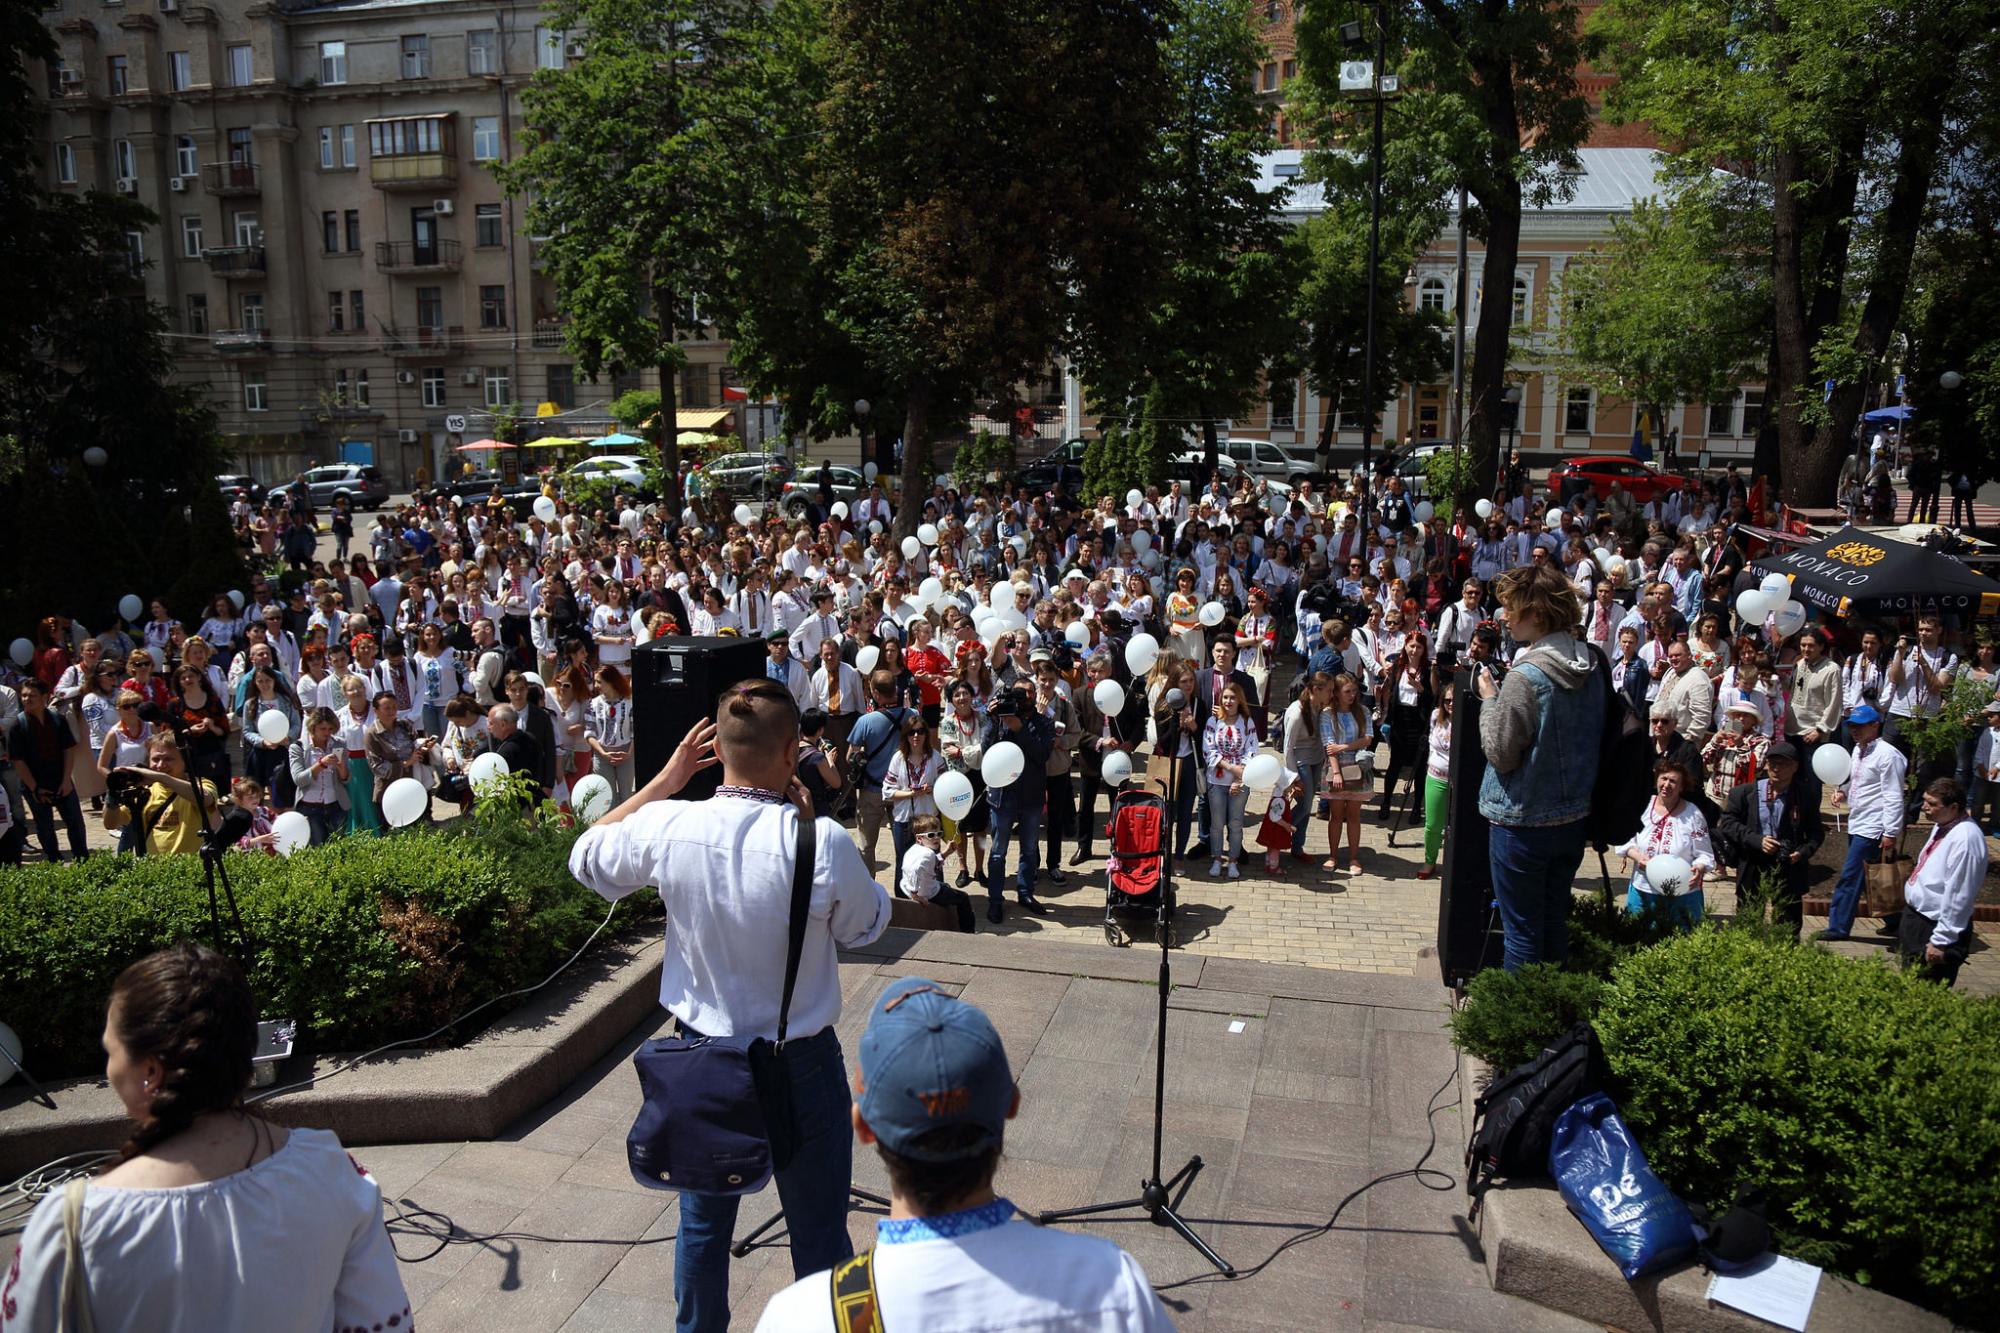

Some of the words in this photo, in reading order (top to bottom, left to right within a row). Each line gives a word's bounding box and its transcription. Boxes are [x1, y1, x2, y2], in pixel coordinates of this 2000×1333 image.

[1780, 552, 1870, 587] MONACO
[1802, 584, 1839, 608] MONACO
[1879, 595, 1969, 609] MONACO
